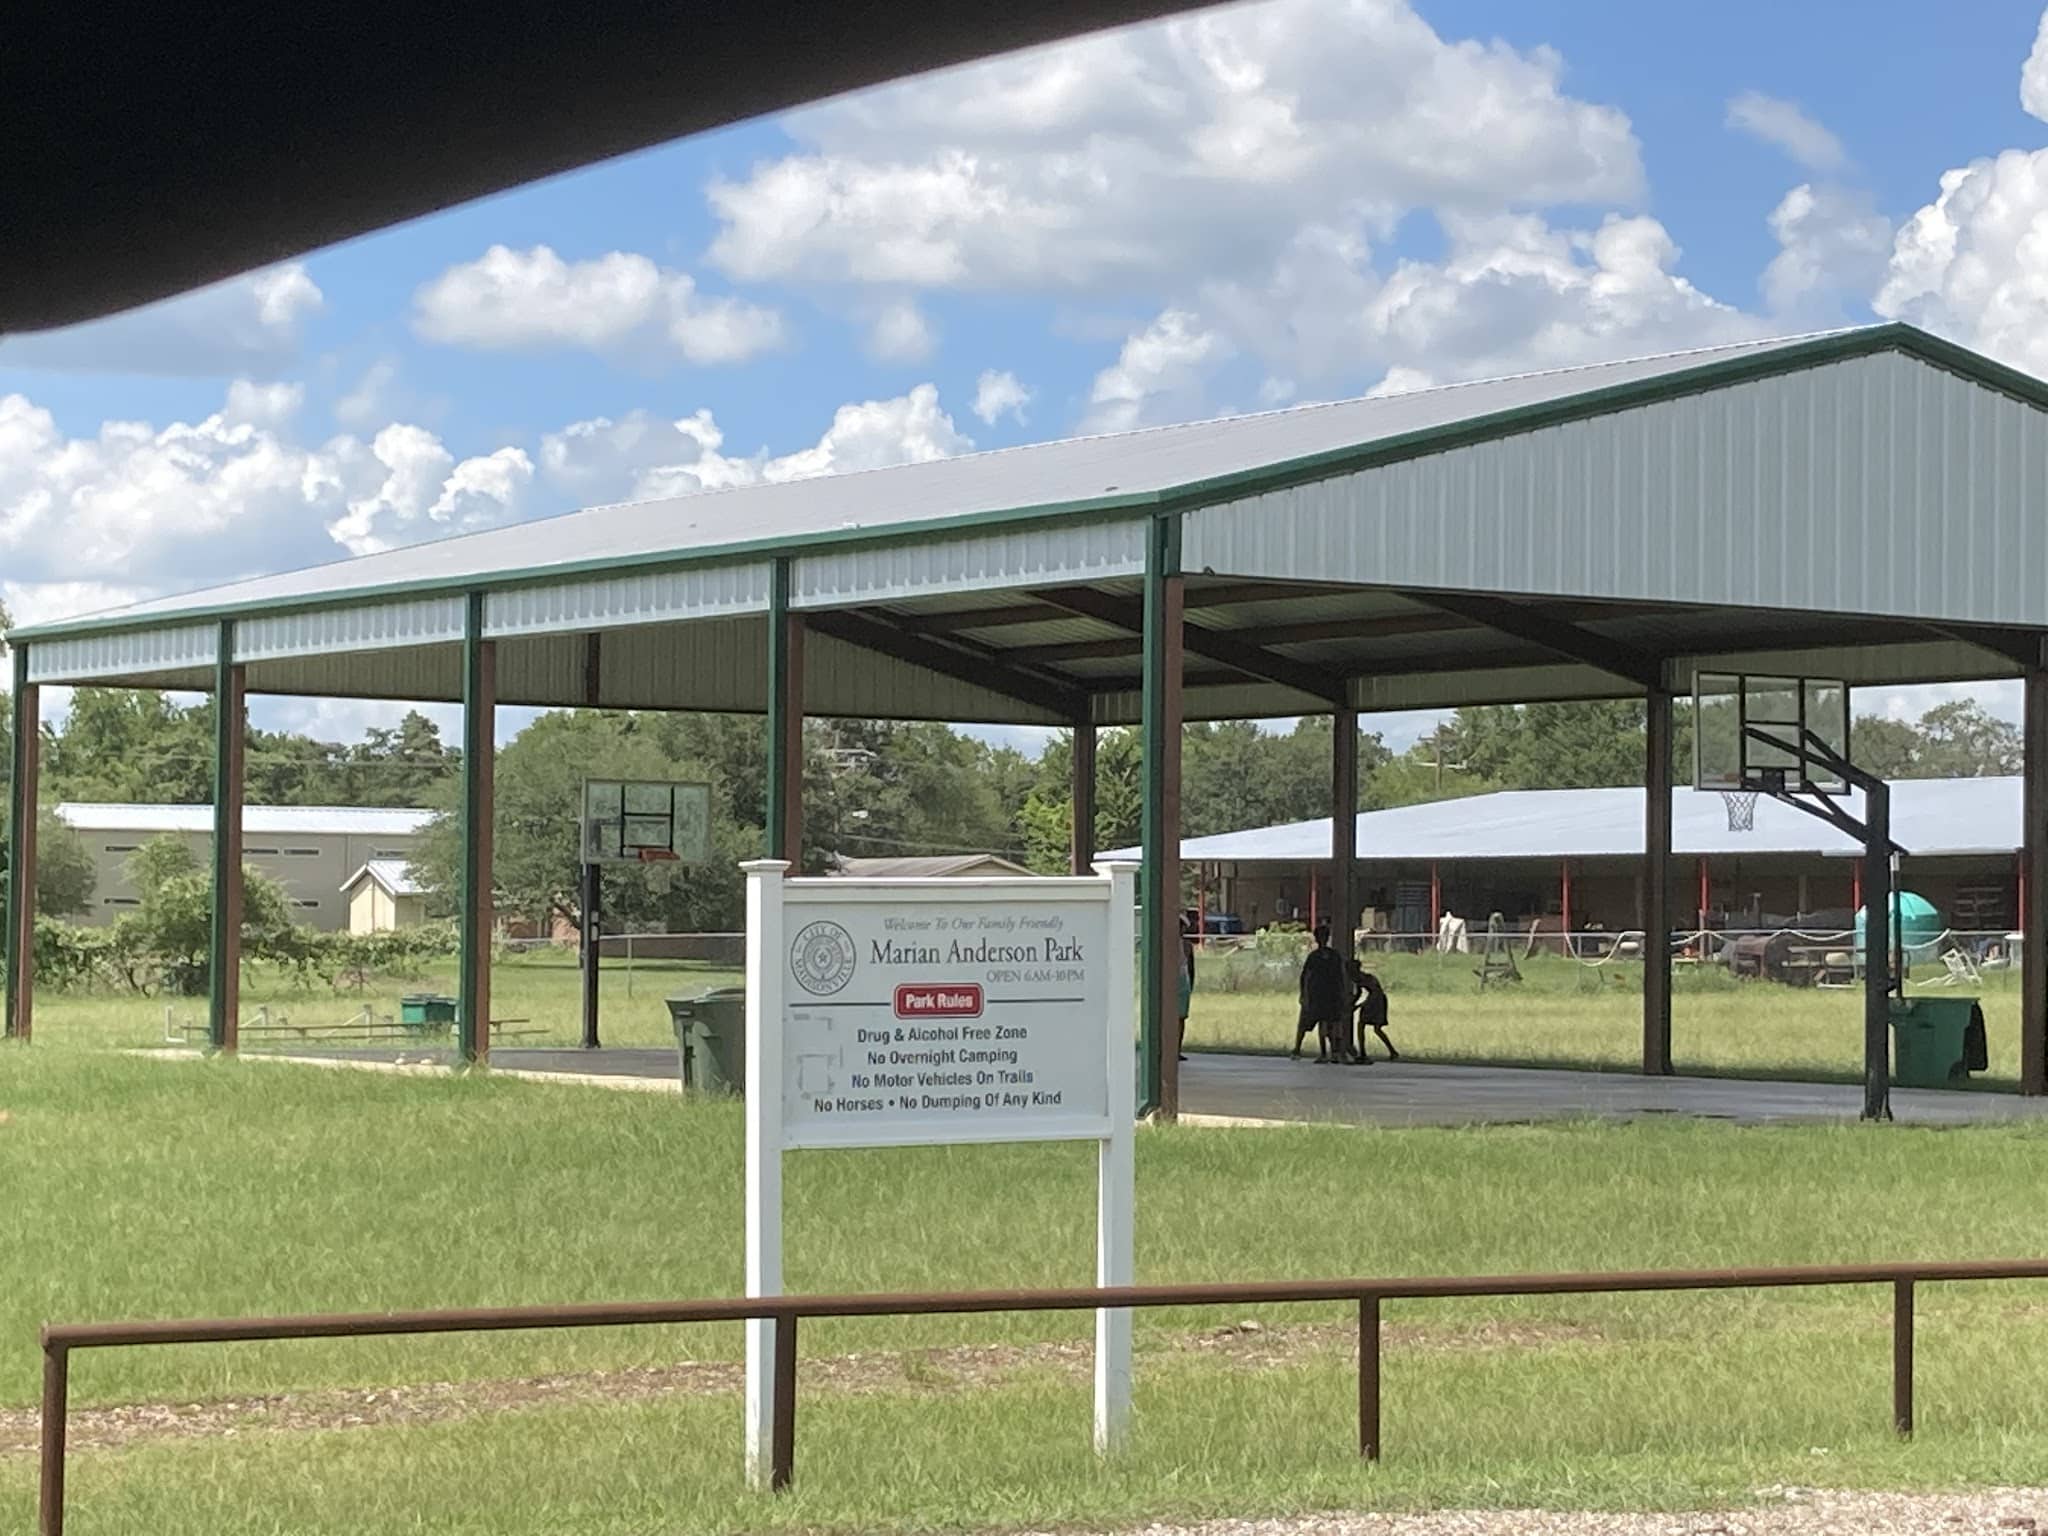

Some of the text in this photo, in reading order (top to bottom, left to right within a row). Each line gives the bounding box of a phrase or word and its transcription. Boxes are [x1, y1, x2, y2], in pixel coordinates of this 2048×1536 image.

[884, 915, 1064, 932] Welcome To Our Family Friendly
[870, 939, 941, 965] Marian
[946, 937, 1039, 963] Anderson
[1044, 936, 1085, 962] Park
[986, 970, 1022, 983] OPEN
[905, 993, 973, 1009] Park Rules
[857, 1025, 1027, 1045] Drug & Alcohol Free Zone
[867, 1049, 1018, 1066] No Overnight Camping
[852, 1070, 1034, 1089] No Motor Vehicles On Trails
[814, 1091, 1062, 1113] No Horses No Dumping Of Any Kind
